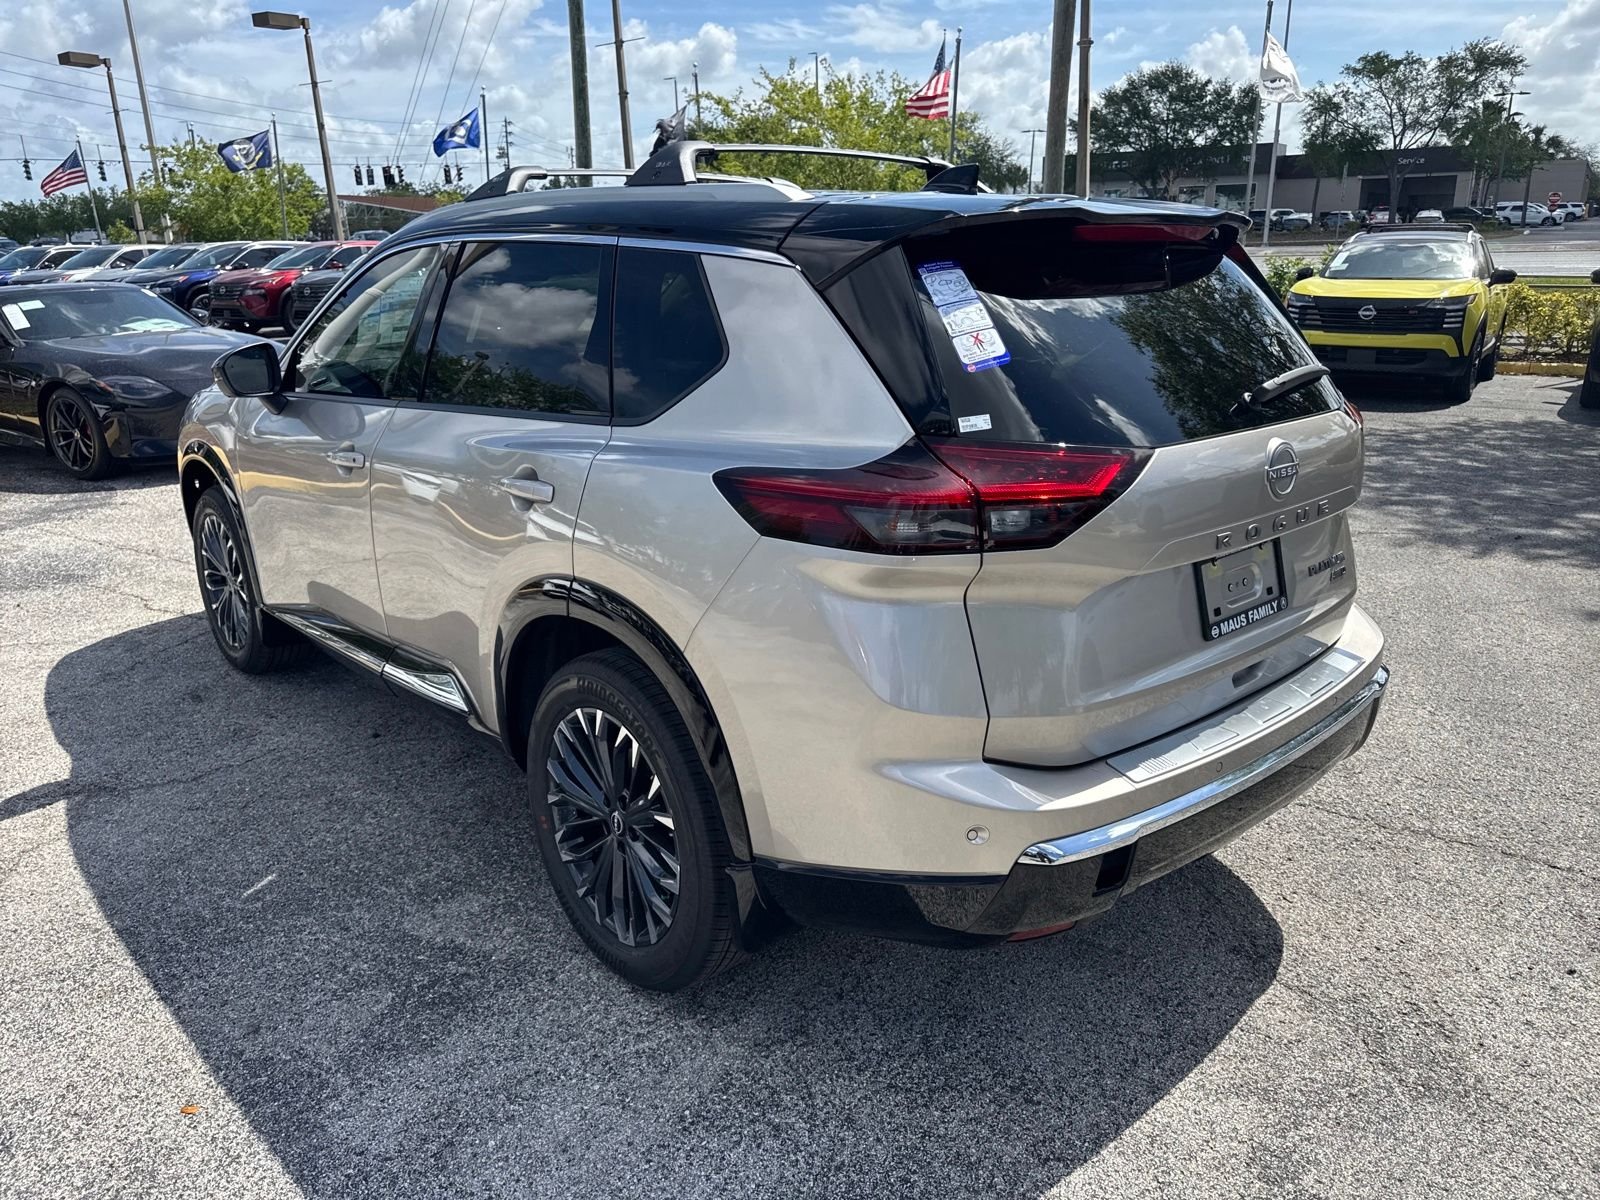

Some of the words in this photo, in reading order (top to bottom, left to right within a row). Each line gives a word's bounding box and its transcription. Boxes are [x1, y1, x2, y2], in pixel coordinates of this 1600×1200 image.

[1269, 464, 1299, 479] NISSA
[1216, 499, 1329, 550] ROGUE
[1220, 613, 1247, 635] MAUS
[1247, 600, 1278, 624] FAMILY
